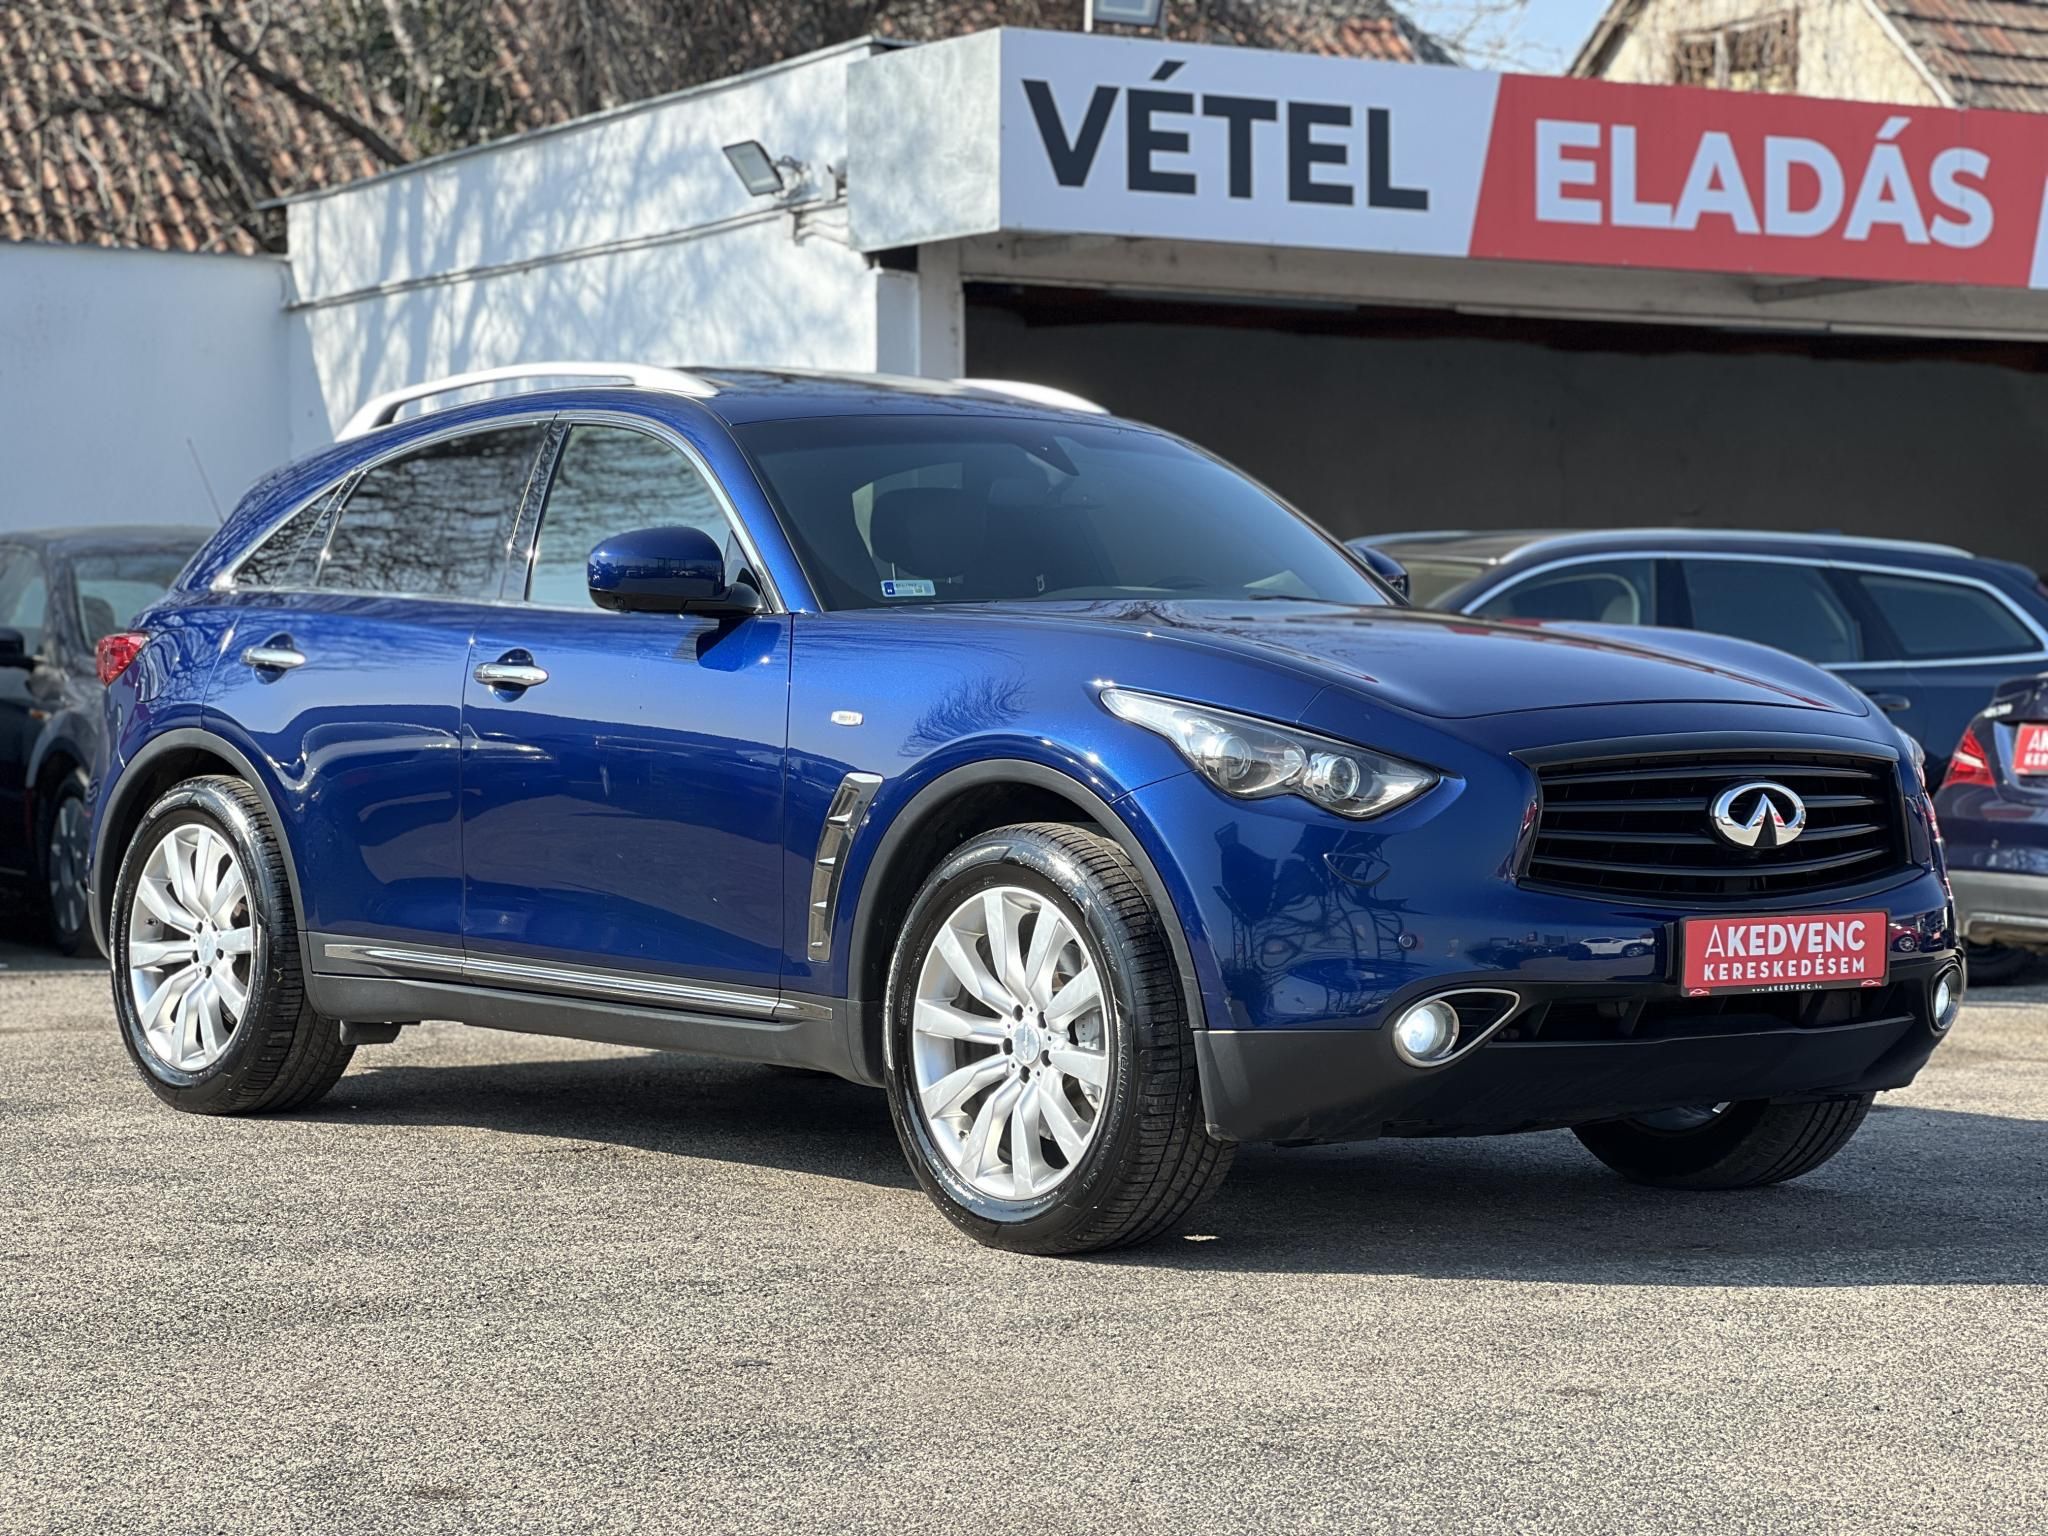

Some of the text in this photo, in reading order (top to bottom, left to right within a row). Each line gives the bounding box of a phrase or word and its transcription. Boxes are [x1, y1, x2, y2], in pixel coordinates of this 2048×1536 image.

[1021, 61, 1994, 249] VÉTEL ELADÁS
[1705, 920, 1866, 958] AKEDVENC
[1704, 954, 1864, 981] KERESKEDÉSEM
